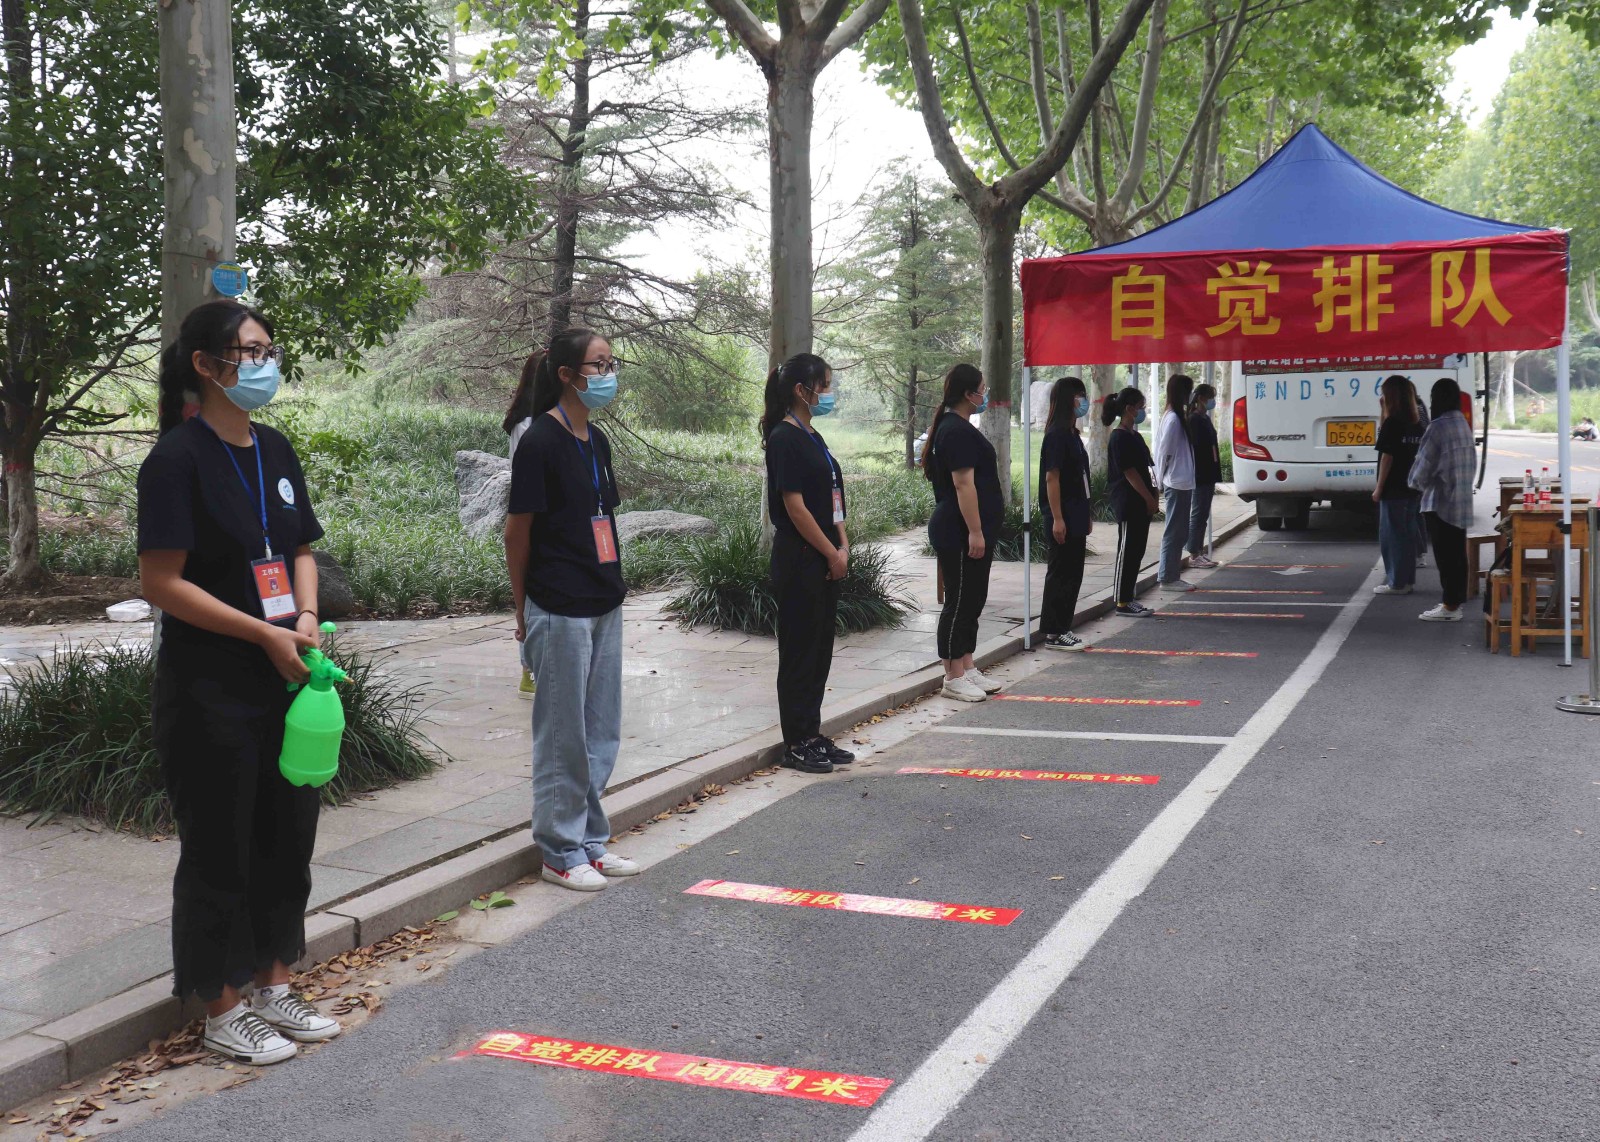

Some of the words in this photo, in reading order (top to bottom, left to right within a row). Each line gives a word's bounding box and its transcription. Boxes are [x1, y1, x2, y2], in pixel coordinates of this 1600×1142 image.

[1110, 247, 1512, 340] 自觉排队
[1255, 377, 1412, 401] 豫ND596
[1330, 431, 1373, 444] D5966
[478, 1033, 659, 1074] 自觉排队
[676, 1062, 860, 1098] 间隔1米
